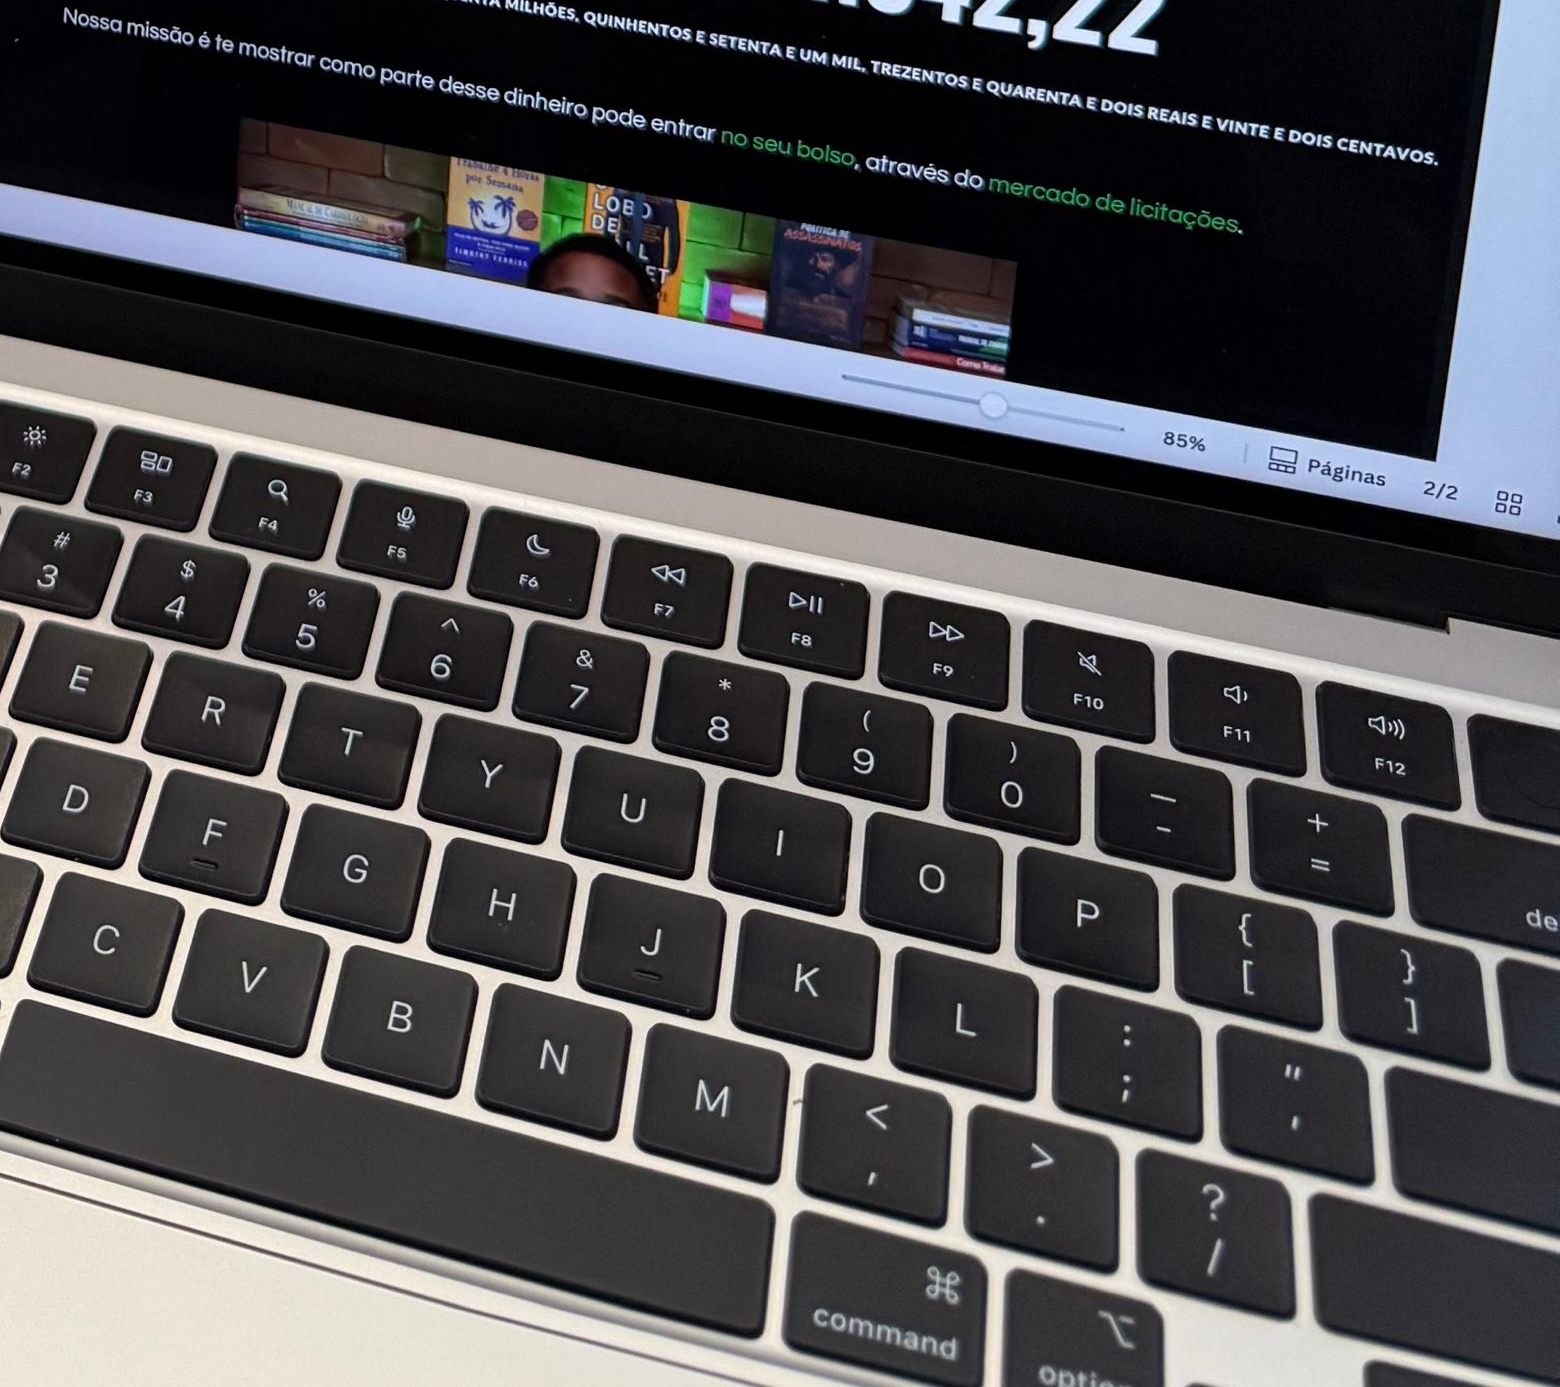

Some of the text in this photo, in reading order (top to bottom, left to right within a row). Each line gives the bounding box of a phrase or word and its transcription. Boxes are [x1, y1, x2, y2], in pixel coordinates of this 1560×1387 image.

[583, 10, 692, 43] QUINHENTOS
[695, 29, 706, 46] E
[708, 31, 783, 59] SETENTA
[785, 44, 797, 61] E
[799, 47, 829, 66] UM
[831, 52, 867, 74] MIL,
[870, 59, 970, 90] TREZENTOS
[971, 76, 983, 93] E
[985, 79, 1084, 109] QUARENTA
[1086, 95, 1098, 112] E
[1100, 97, 1145, 120] DOIS
[1147, 105, 1199, 128] REAIS
[1201, 113, 1213, 131] E
[1216, 116, 1271, 140] VINTE
[1273, 125, 1286, 143] E
[1287, 128, 1333, 150] DOIS
[1336, 136, 1439, 166] CENTAVOS.
[63, 6, 1243, 236] Nossa missão é te mostrar como parte desse dinheiro pode entrar no seu bolso, através do mercado de licitações.
[1163, 430, 1206, 453] 85%
[11, 462, 32, 476] F2
[1307, 457, 1386, 488] Páginas
[133, 489, 153, 503] F3
[1423, 480, 1458, 502] 2/2
[258, 516, 278, 531] F4
[387, 544, 407, 559] F5
[518, 573, 539, 588] F6
[654, 603, 674, 617] F7
[791, 632, 812, 647] F8
[932, 662, 954, 677] F9
[1073, 693, 1104, 710] F10
[1223, 725, 1250, 743] F11
[1374, 757, 1406, 776] F12
[812, 1307, 960, 1362] command
